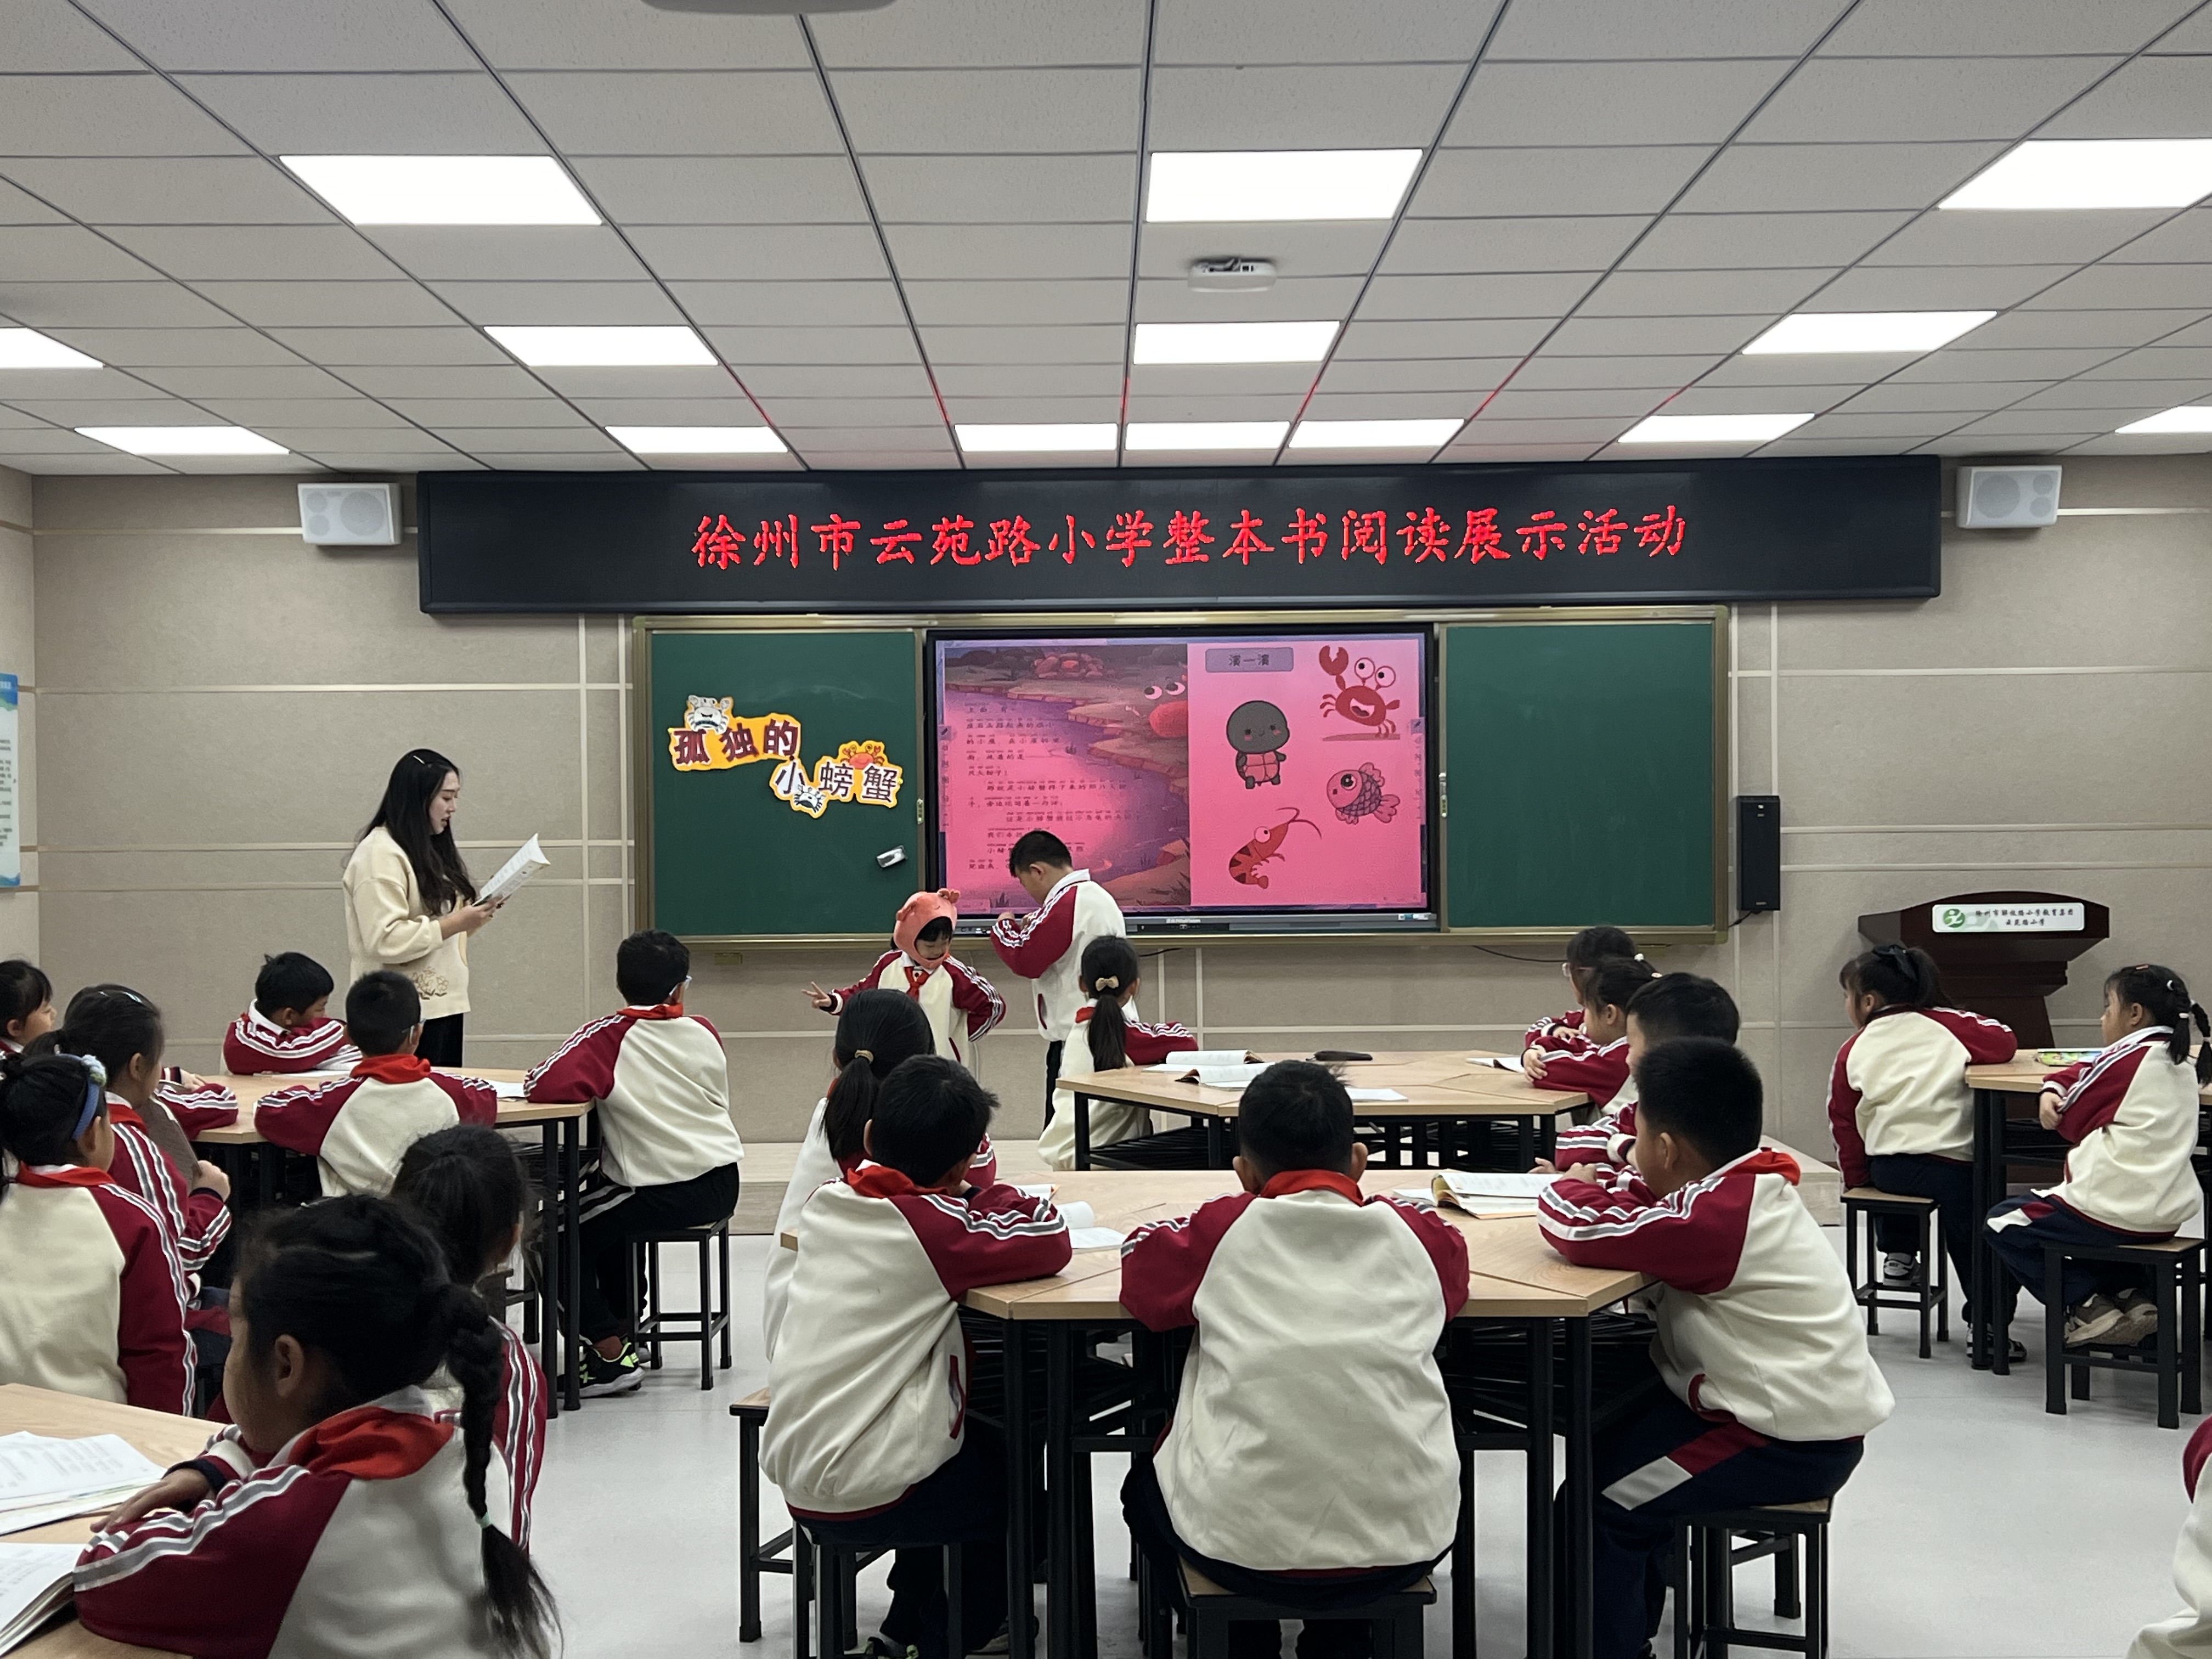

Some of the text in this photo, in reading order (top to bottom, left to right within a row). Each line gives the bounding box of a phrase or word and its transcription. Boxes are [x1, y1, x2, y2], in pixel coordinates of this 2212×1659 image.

[692, 506, 1688, 571] 徐州市云苑路小学整本书阅读展示活动
[1228, 654, 1269, 667] 演一演
[674, 719, 799, 765] 孤独的
[775, 756, 898, 803] 小螃蟹
